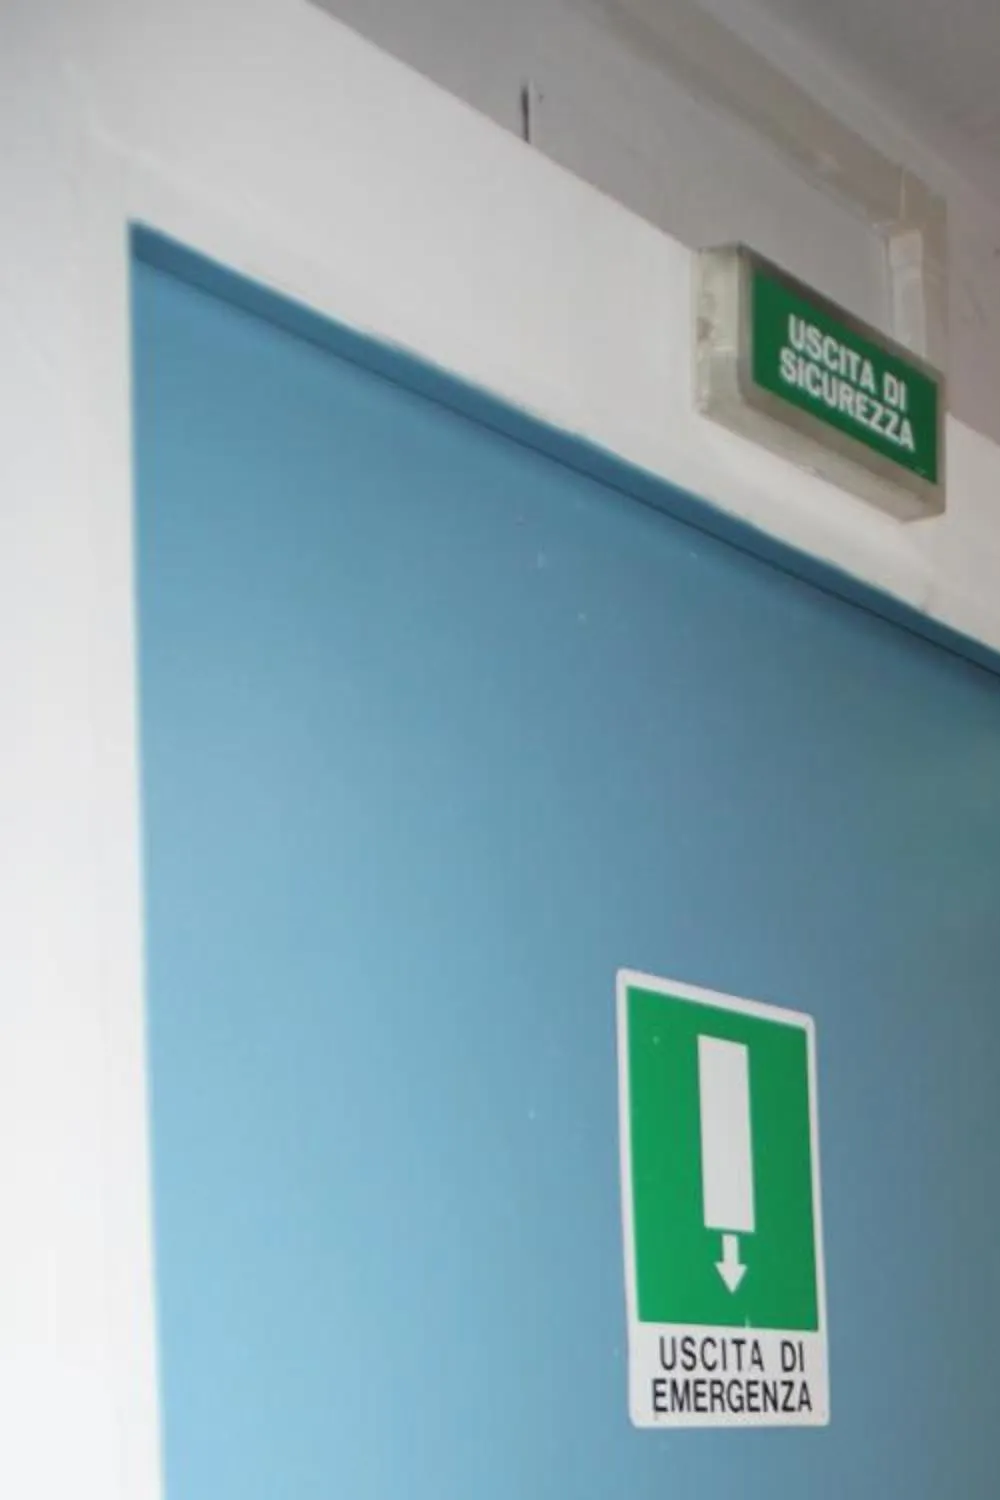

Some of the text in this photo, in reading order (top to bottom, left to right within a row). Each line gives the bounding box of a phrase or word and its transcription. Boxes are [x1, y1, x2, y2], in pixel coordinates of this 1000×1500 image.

[789, 312, 908, 410] USCITA DI
[779, 346, 916, 452] SICUREZZA
[659, 1335, 805, 1373] USCITA DI
[652, 1377, 813, 1414] EMERGENZA
